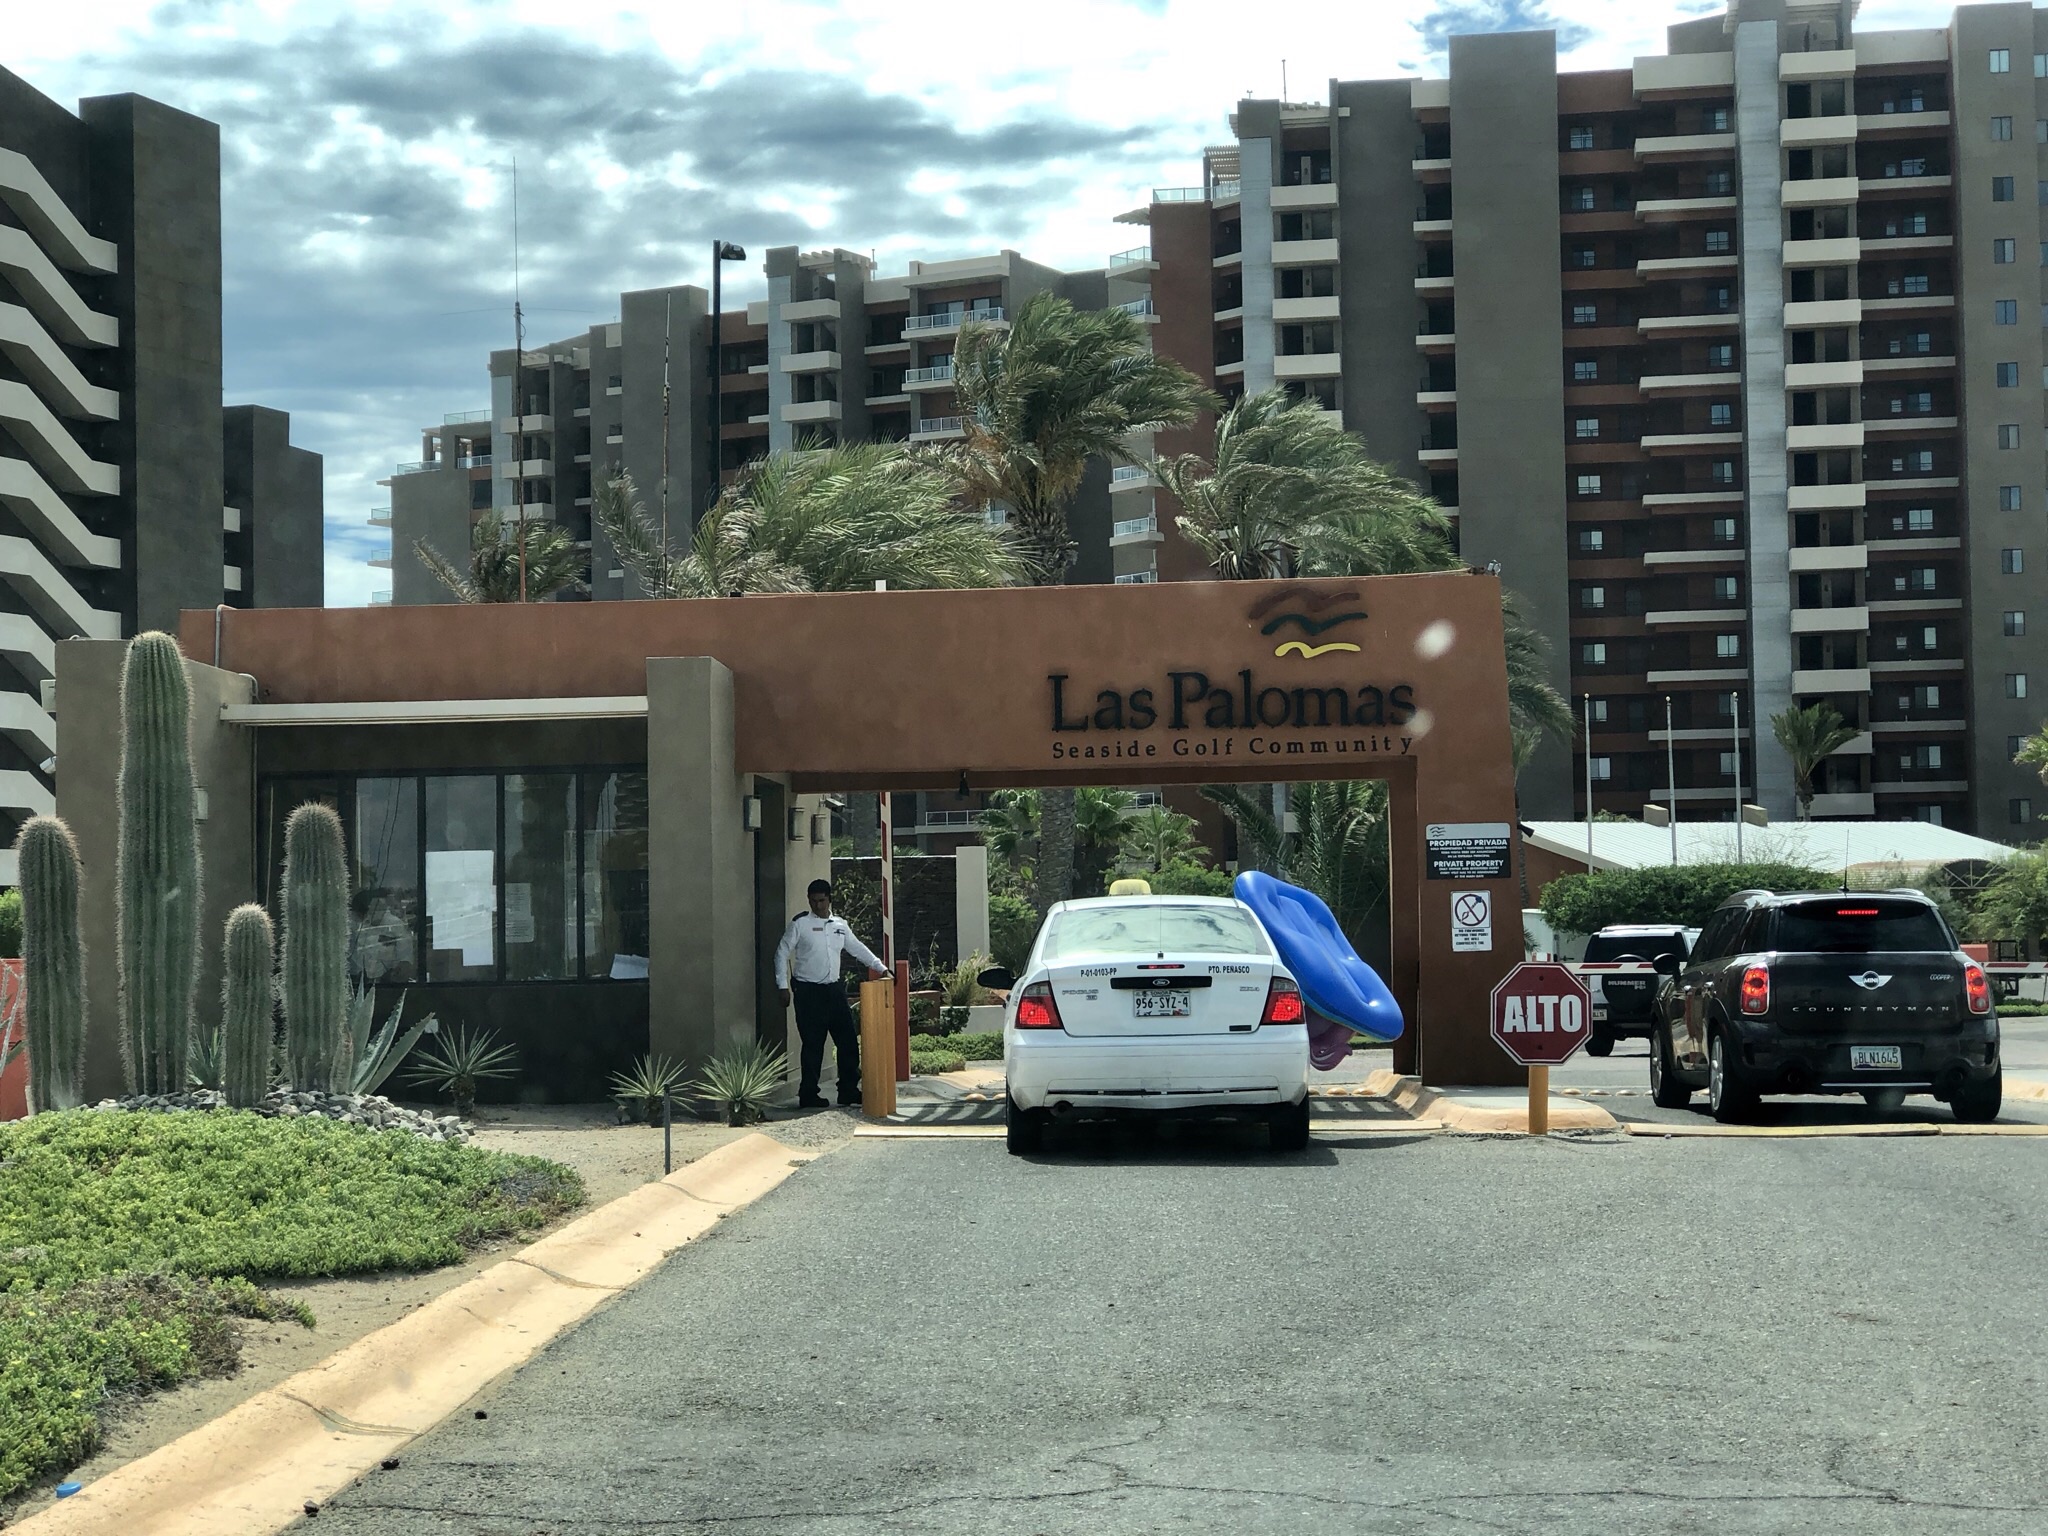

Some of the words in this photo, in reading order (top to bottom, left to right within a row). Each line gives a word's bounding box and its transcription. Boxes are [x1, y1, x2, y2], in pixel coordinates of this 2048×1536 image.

[1047, 674, 1157, 732] Las
[1167, 669, 1417, 731] Palomas
[1053, 741, 1156, 758] Seaside
[1173, 740, 1233, 756] Golf
[1249, 735, 1412, 754] Community
[1208, 965, 1222, 974] PTO.
[1135, 996, 1189, 1009] 956-SYZ-4
[1503, 994, 1583, 1033] ALTO
[1858, 1051, 1899, 1064] BLN1645
